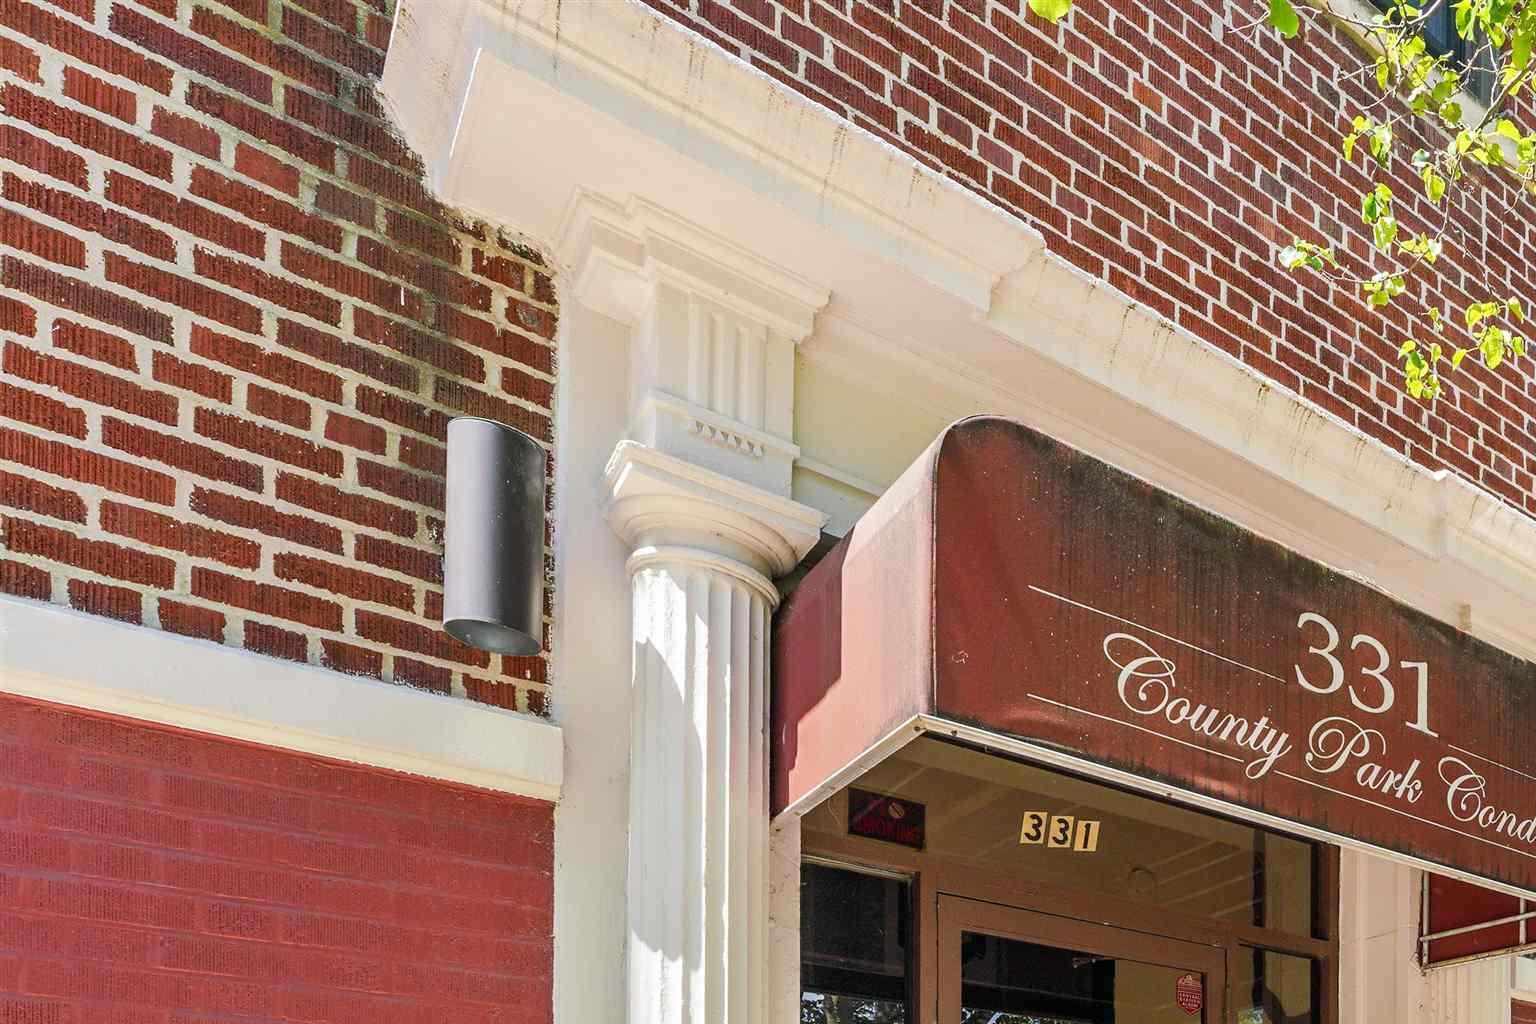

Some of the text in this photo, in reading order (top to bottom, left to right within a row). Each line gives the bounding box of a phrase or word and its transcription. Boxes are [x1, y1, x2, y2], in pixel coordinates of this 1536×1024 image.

[1103, 632, 1292, 779] County
[1305, 716, 1423, 804] Park
[1294, 611, 1440, 738] 331
[1023, 813, 1091, 849] 331
